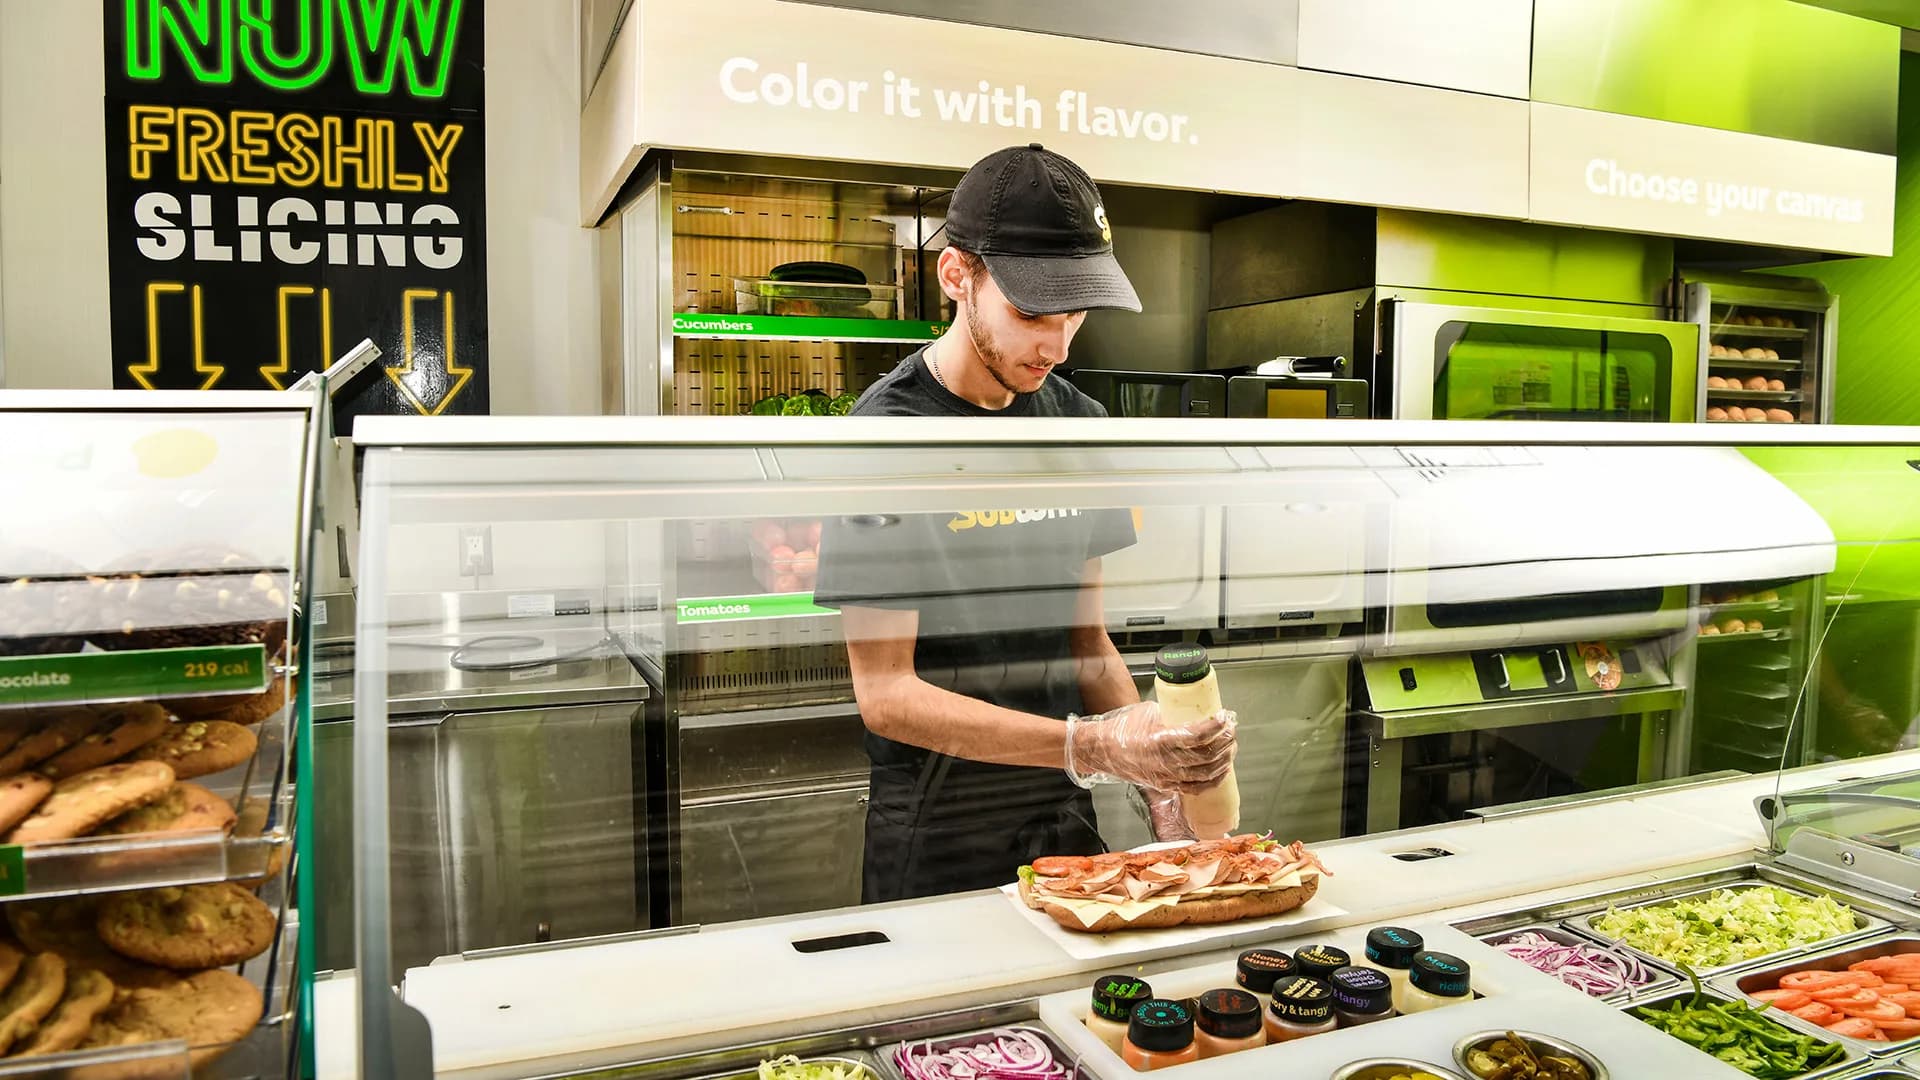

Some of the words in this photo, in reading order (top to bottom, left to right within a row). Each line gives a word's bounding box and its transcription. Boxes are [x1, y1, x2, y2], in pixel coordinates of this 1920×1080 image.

[124, 0, 463, 97] NOW
[719, 57, 868, 112] Color
[882, 70, 921, 118] it
[934, 80, 1042, 130] with
[1056, 89, 1199, 145] flavor.
[129, 105, 463, 193] FRESHLY
[1585, 158, 1698, 204] Choose
[1705, 180, 1771, 216] your
[1775, 189, 1865, 223] canvas
[134, 192, 464, 270] SLICING
[673, 317, 754, 332] Cucumbers
[677, 603, 751, 617] Tomatoes
[1163, 649, 1201, 659] Ranch
[184, 662, 218, 678] 219
[222, 661, 249, 676] cal
[1243, 956, 1288, 969] Mustard
[1252, 953, 1287, 964] Honey
[1424, 954, 1459, 971] Mayo
[1340, 991, 1371, 1008] tangy
[1289, 1004, 1296, 1015] &
[1298, 1006, 1328, 1017] tangy
